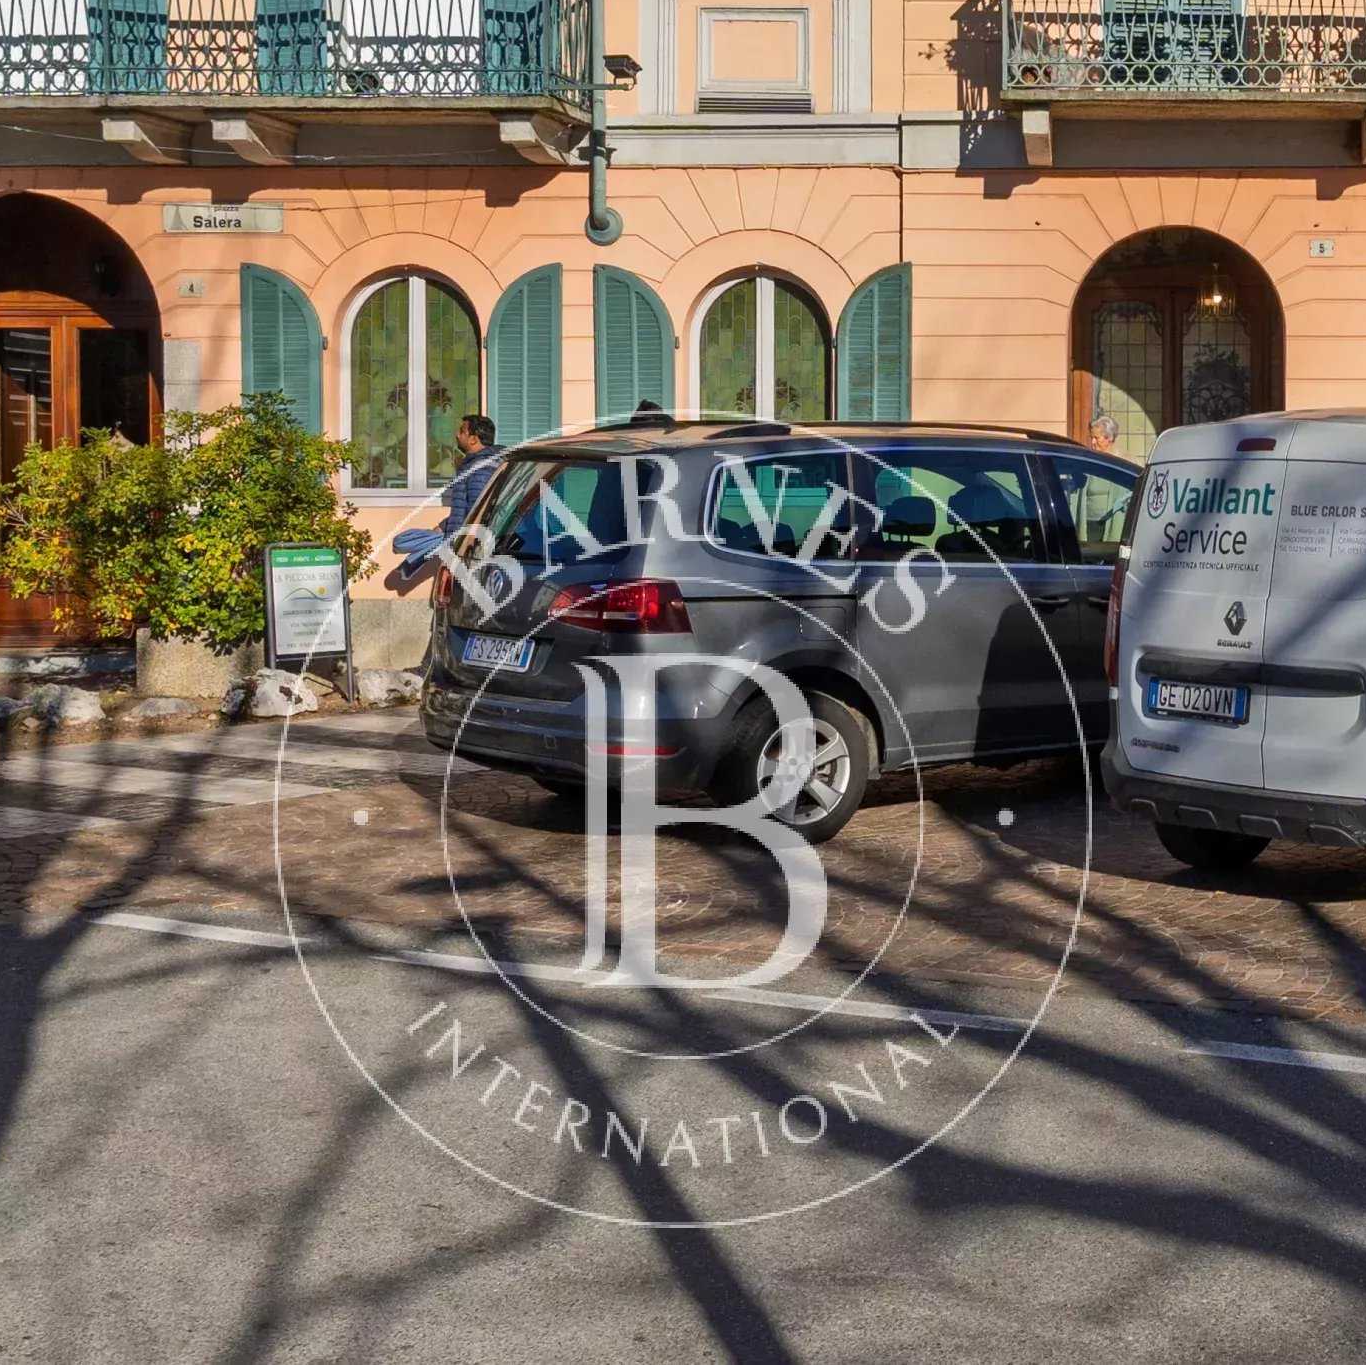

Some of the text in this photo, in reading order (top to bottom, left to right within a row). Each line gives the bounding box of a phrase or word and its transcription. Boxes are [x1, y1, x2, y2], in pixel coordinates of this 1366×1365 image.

[192, 215, 243, 229] Salera
[1172, 478, 1276, 516] Vaillant
[1290, 504, 1319, 516] BLUE
[1321, 505, 1356, 518] CALOR
[1161, 521, 1248, 555] Service
[1159, 683, 1178, 707] GE
